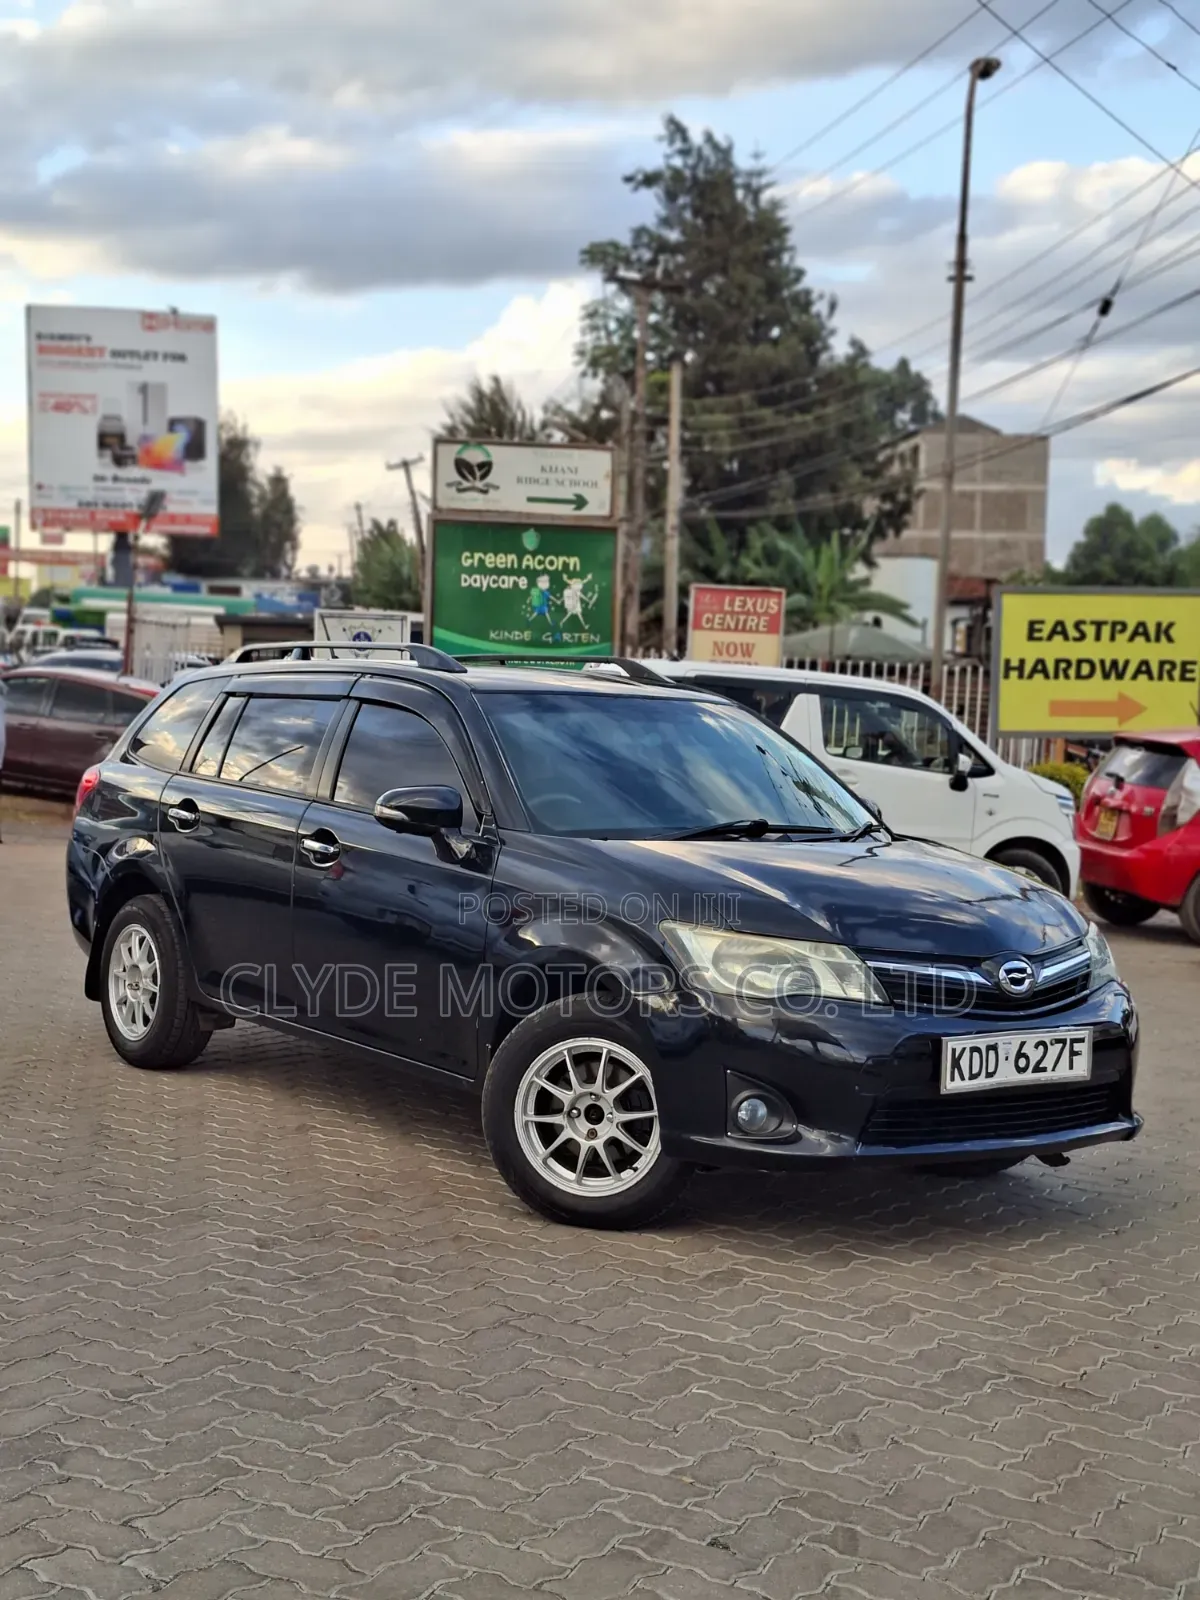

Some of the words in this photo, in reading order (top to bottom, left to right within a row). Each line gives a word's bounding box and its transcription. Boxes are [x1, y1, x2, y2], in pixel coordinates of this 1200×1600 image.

[723, 596, 779, 614] LEXUS
[702, 613, 770, 632] CENTRE
[1026, 619, 1176, 644] EASTPAK
[712, 641, 756, 659] NOW
[1003, 658, 1198, 683] HARDWARE
[950, 1042, 1000, 1083] KDD
[1013, 1037, 1086, 1075] 627F
